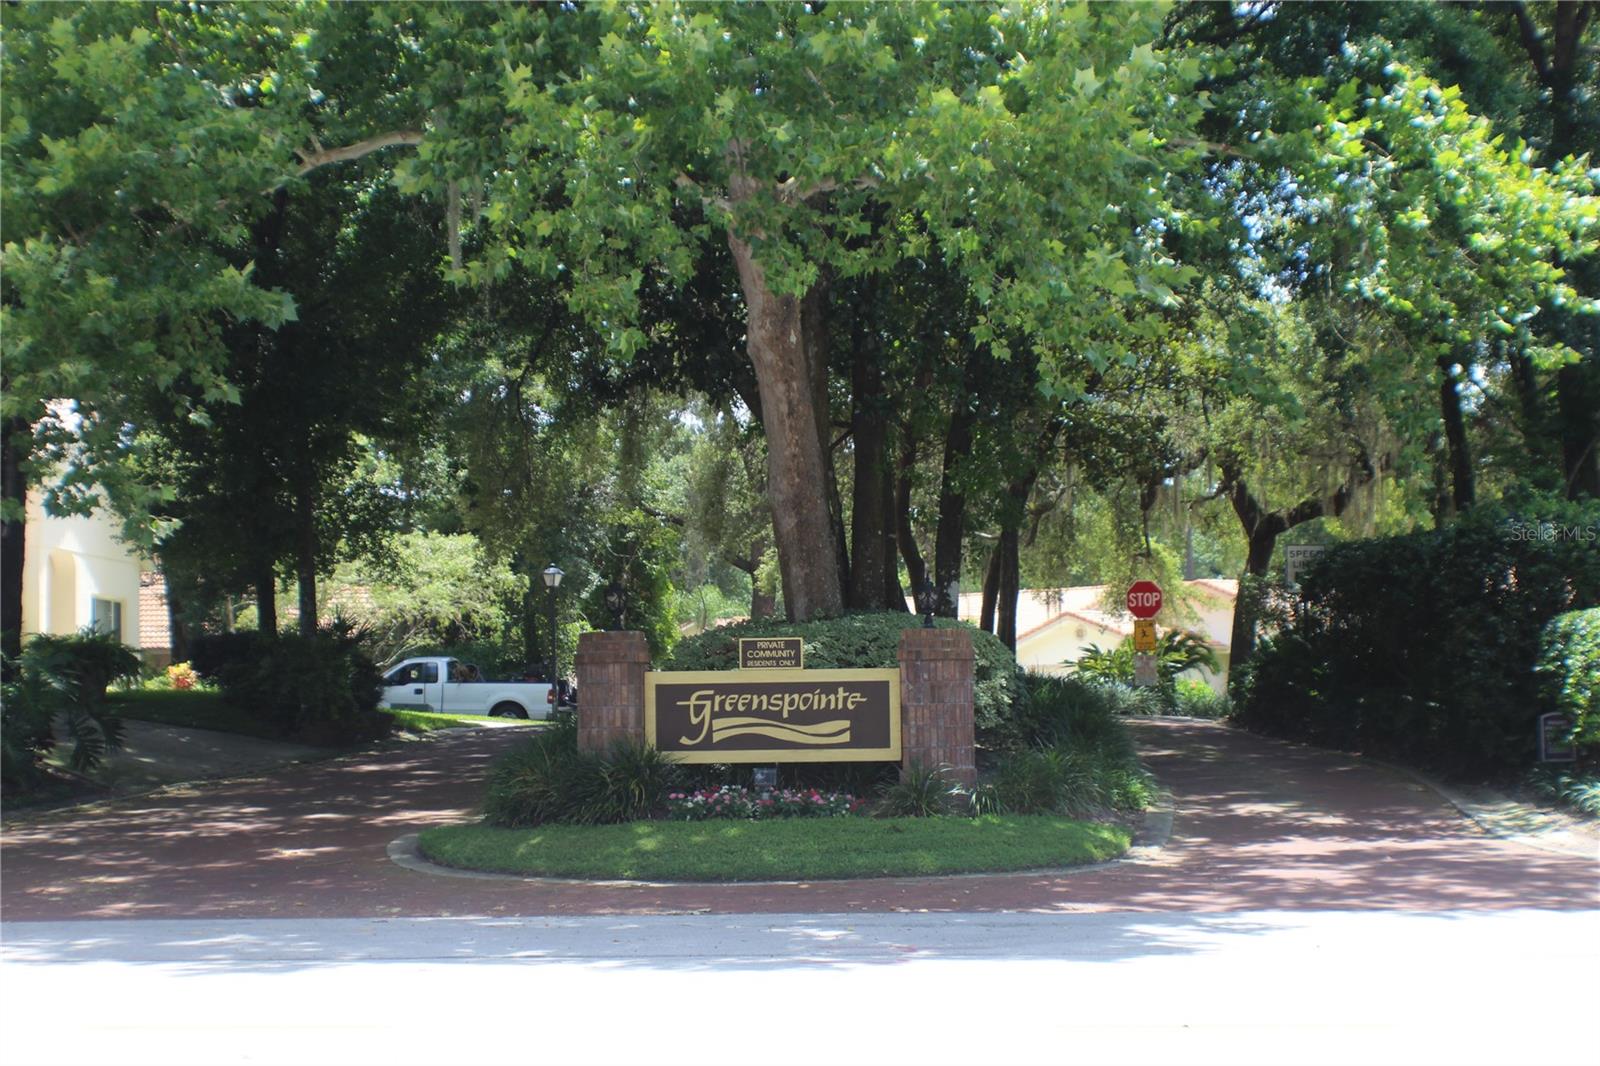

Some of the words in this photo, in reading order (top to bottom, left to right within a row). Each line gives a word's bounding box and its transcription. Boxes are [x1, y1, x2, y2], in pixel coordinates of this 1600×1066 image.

[1289, 550, 1324, 559] SPEE
[1128, 592, 1160, 608] STOP
[756, 641, 785, 649] PRIVATE
[746, 650, 796, 658] COMMUNITY
[779, 659, 796, 667] ONLY
[676, 686, 868, 746] Greenspointe
